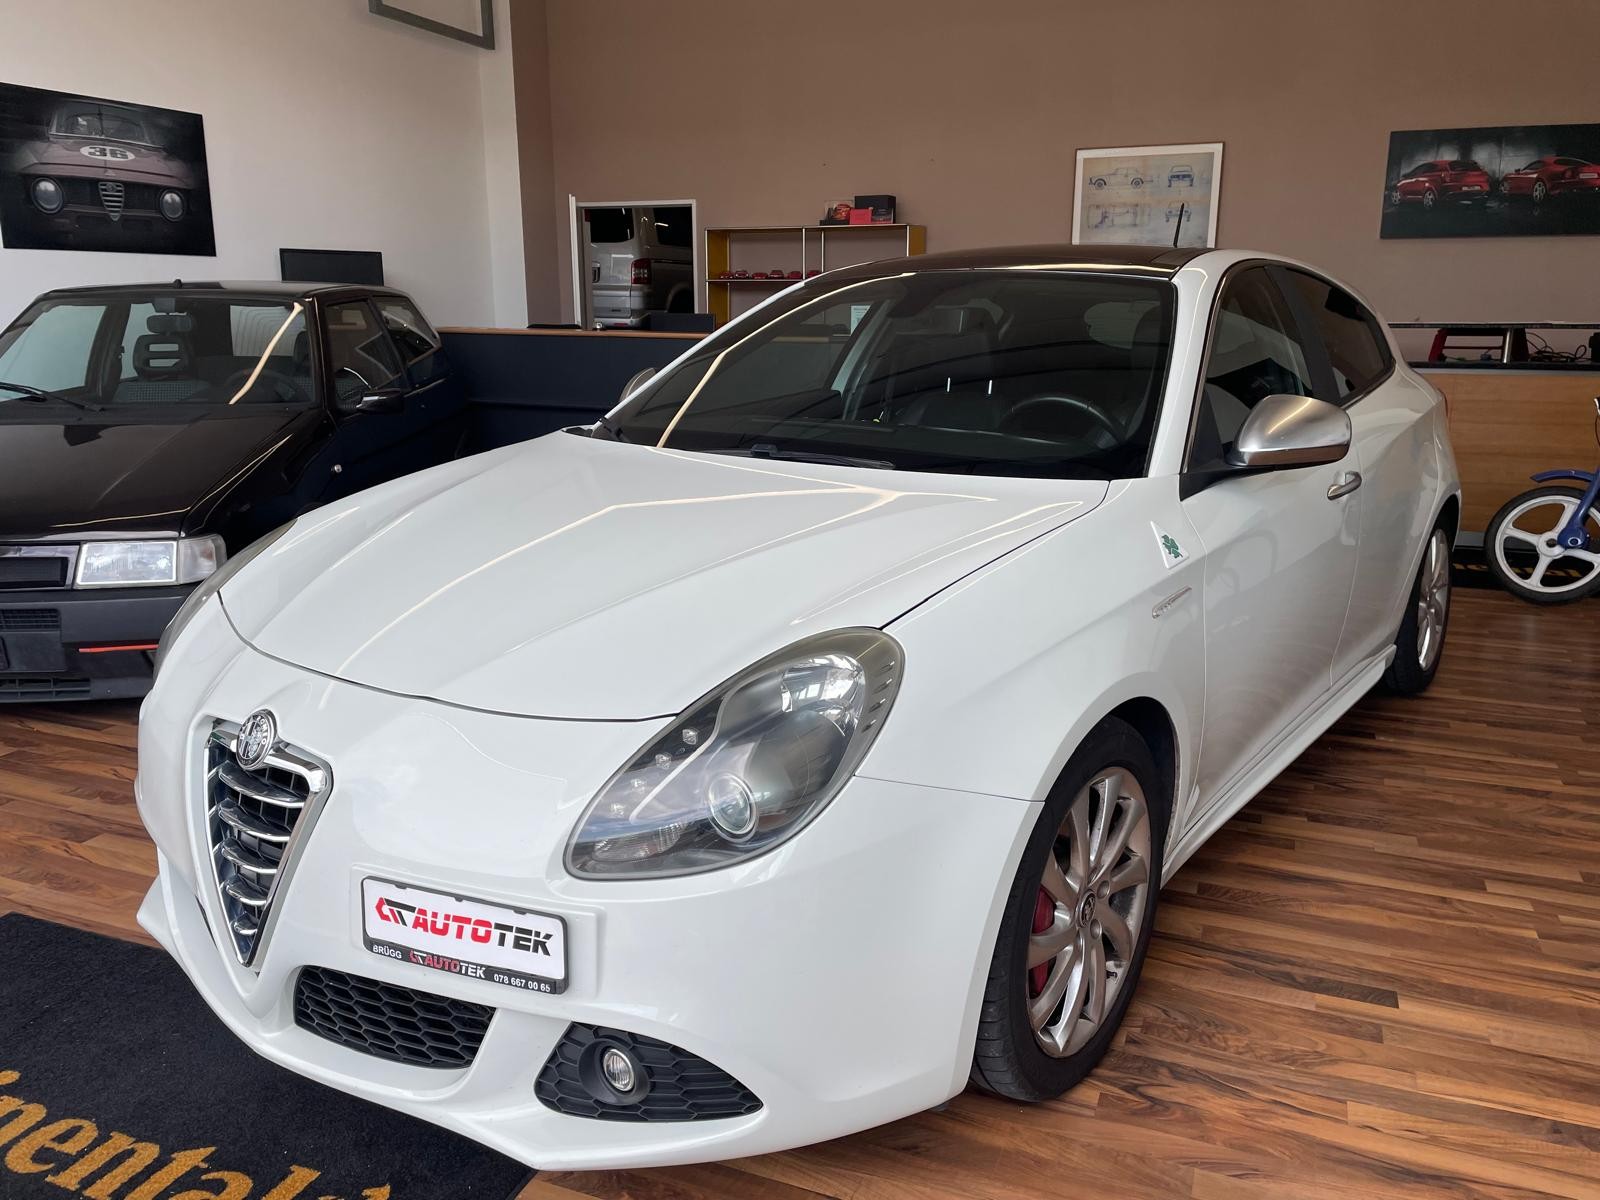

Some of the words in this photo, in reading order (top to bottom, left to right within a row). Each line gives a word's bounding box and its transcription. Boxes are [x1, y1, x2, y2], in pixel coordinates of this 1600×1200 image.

[411, 907, 554, 957] AUTOTEK
[372, 944, 402, 959] BRÜGG
[424, 954, 486, 979] AUTOTEK
[493, 973, 509, 984] 078
[510, 977, 526, 988] 667
[527, 981, 539, 990] 00
[540, 983, 551, 993] 65
